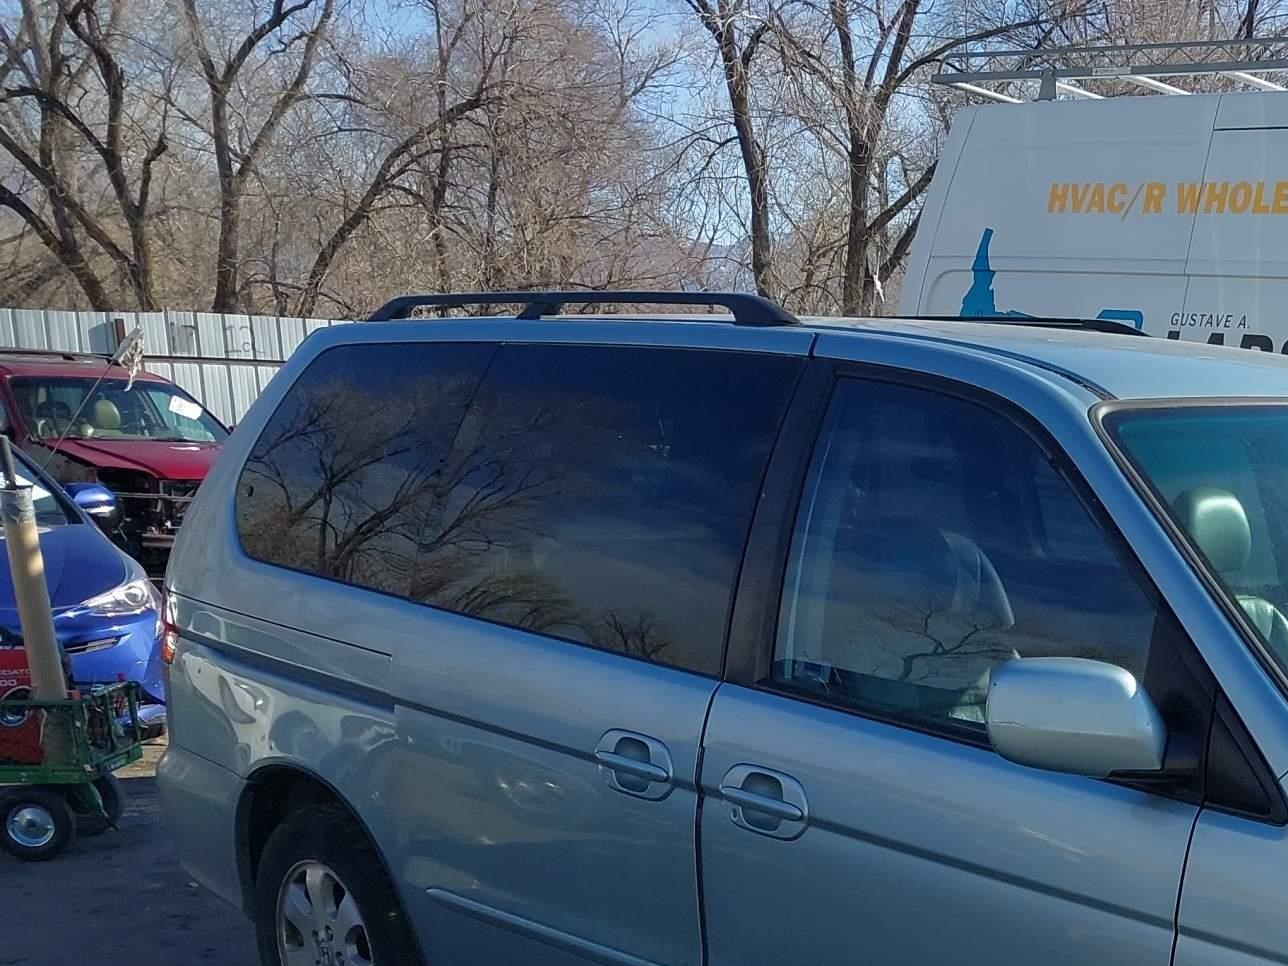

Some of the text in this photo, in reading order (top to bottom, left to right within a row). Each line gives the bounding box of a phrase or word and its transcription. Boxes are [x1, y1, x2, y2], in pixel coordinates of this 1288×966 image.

[1047, 182, 1167, 220] HVAC/R
[1170, 312, 1250, 329] GUSTAVE A.
